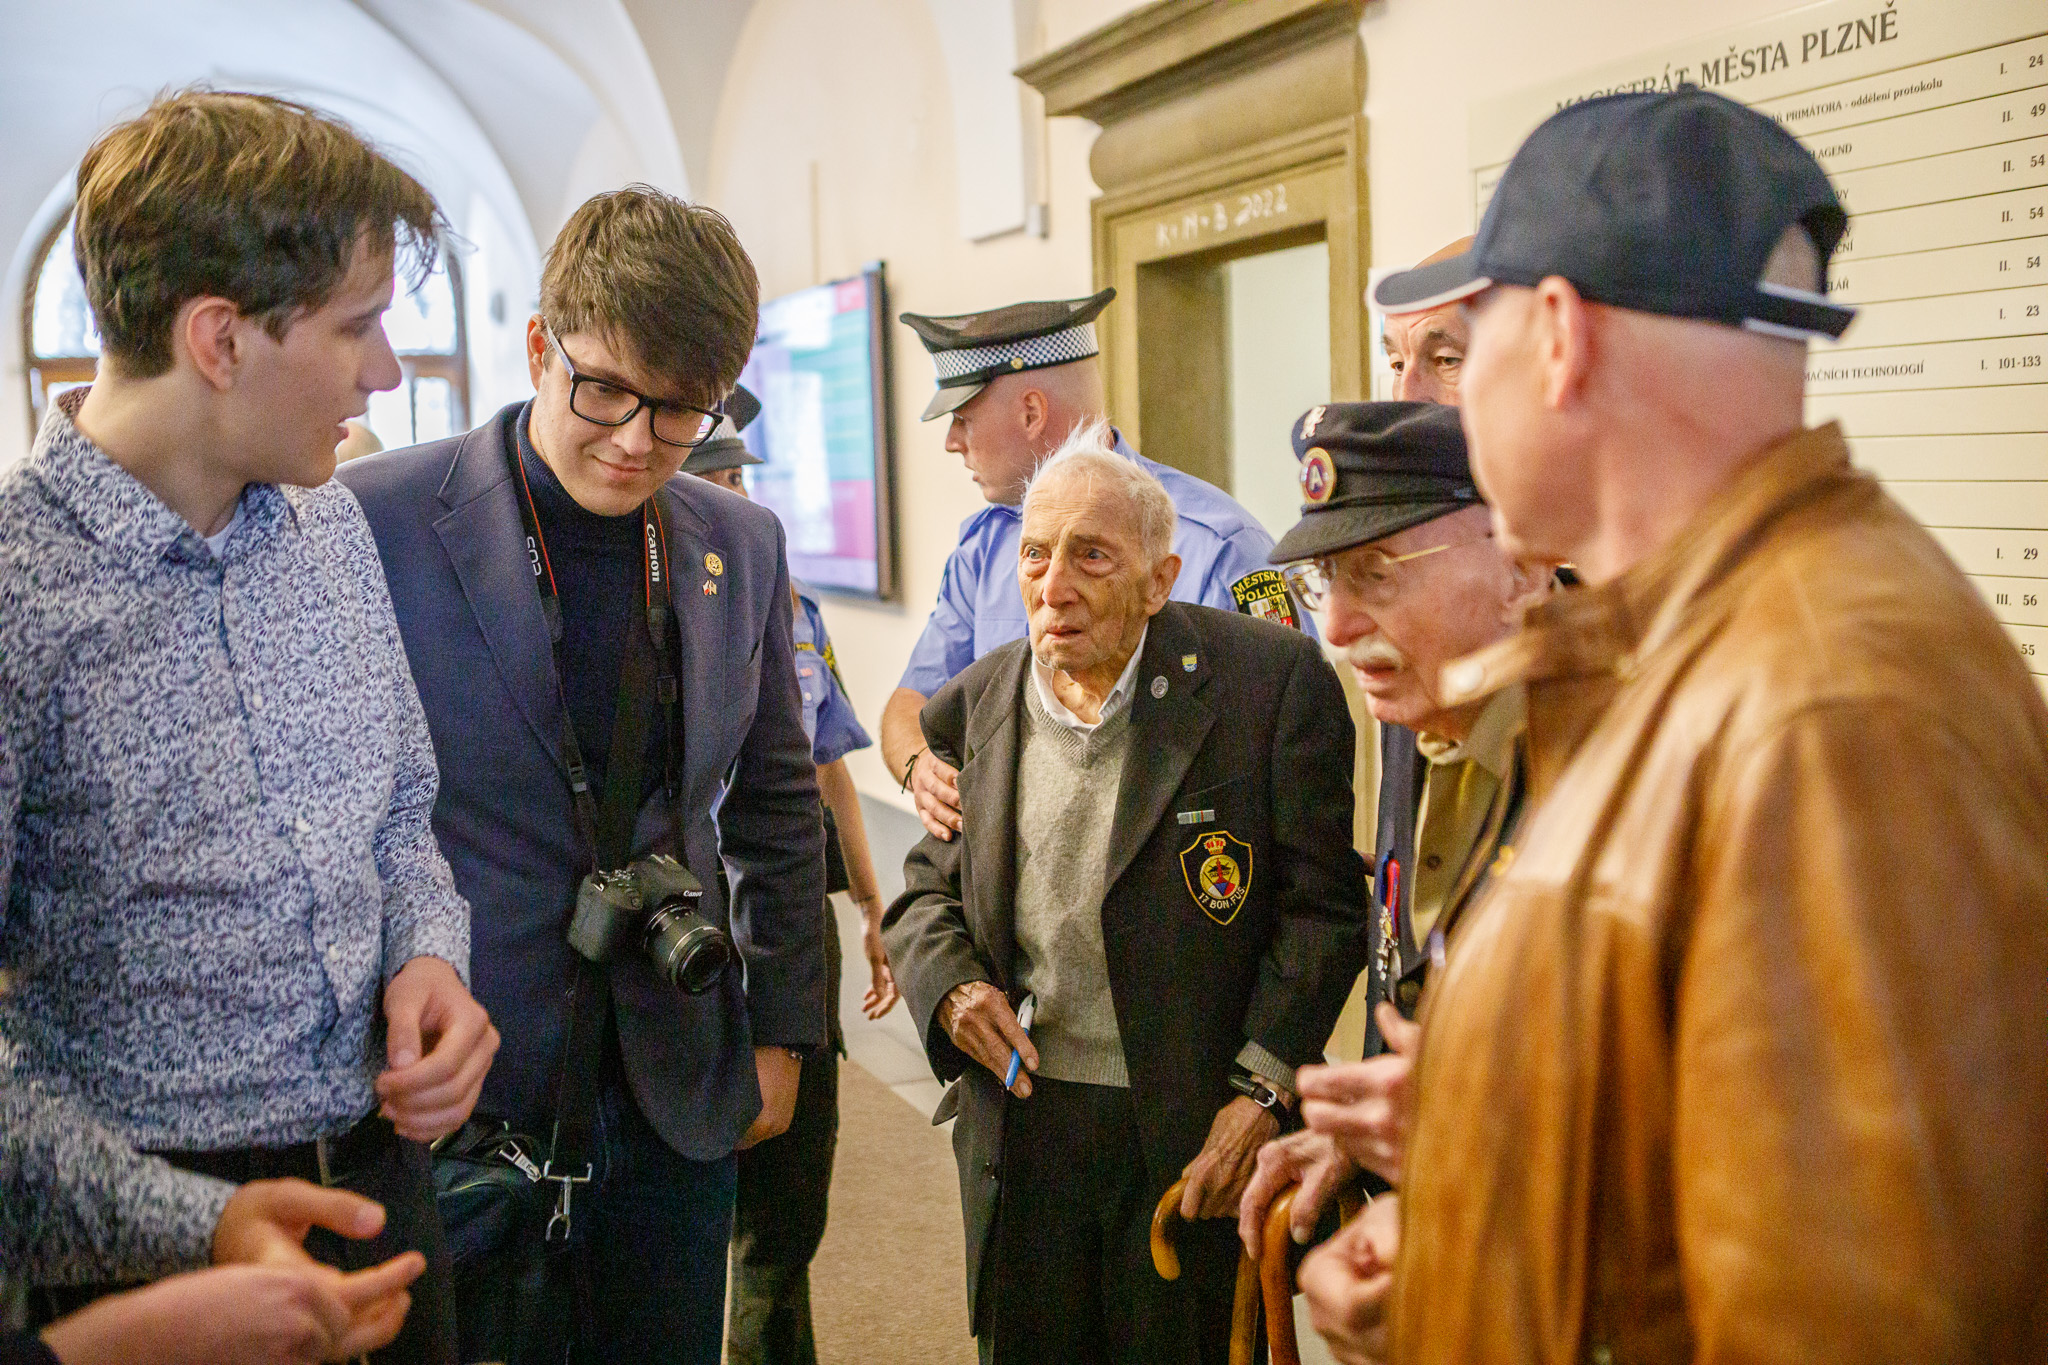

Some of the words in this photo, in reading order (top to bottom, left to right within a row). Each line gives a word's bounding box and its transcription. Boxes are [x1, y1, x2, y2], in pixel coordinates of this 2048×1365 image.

[1555, 63, 1690, 113] MTRÁT
[1700, 41, 1789, 89] MĚSTA
[1801, 0, 1899, 64] PLZNĚ
[2028, 54, 2044, 68] 24
[1786, 99, 1842, 122] PRIMÁTORA
[1851, 88, 1891, 108] oddělení
[1893, 78, 1943, 101] protokolu
[2030, 103, 2046, 118] 49
[1818, 143, 1852, 159] AGEND
[2030, 154, 2045, 168] 54
[1233, 183, 1288, 227] 2022
[2029, 206, 2044, 220] 54
[2026, 255, 2041, 269] 54
[2026, 304, 2040, 317] 23
[1852, 359, 1925, 379] TECHNOLOGIÍ
[1999, 355, 2041, 370] 101-133
[647, 523, 660, 582] Canon
[2023, 547, 2038, 560] 29
[1236, 582, 1288, 605] POLICIE
[2023, 594, 2037, 606] 56
[2020, 643, 2035, 656] 55
[1198, 892, 1210, 904] 17
